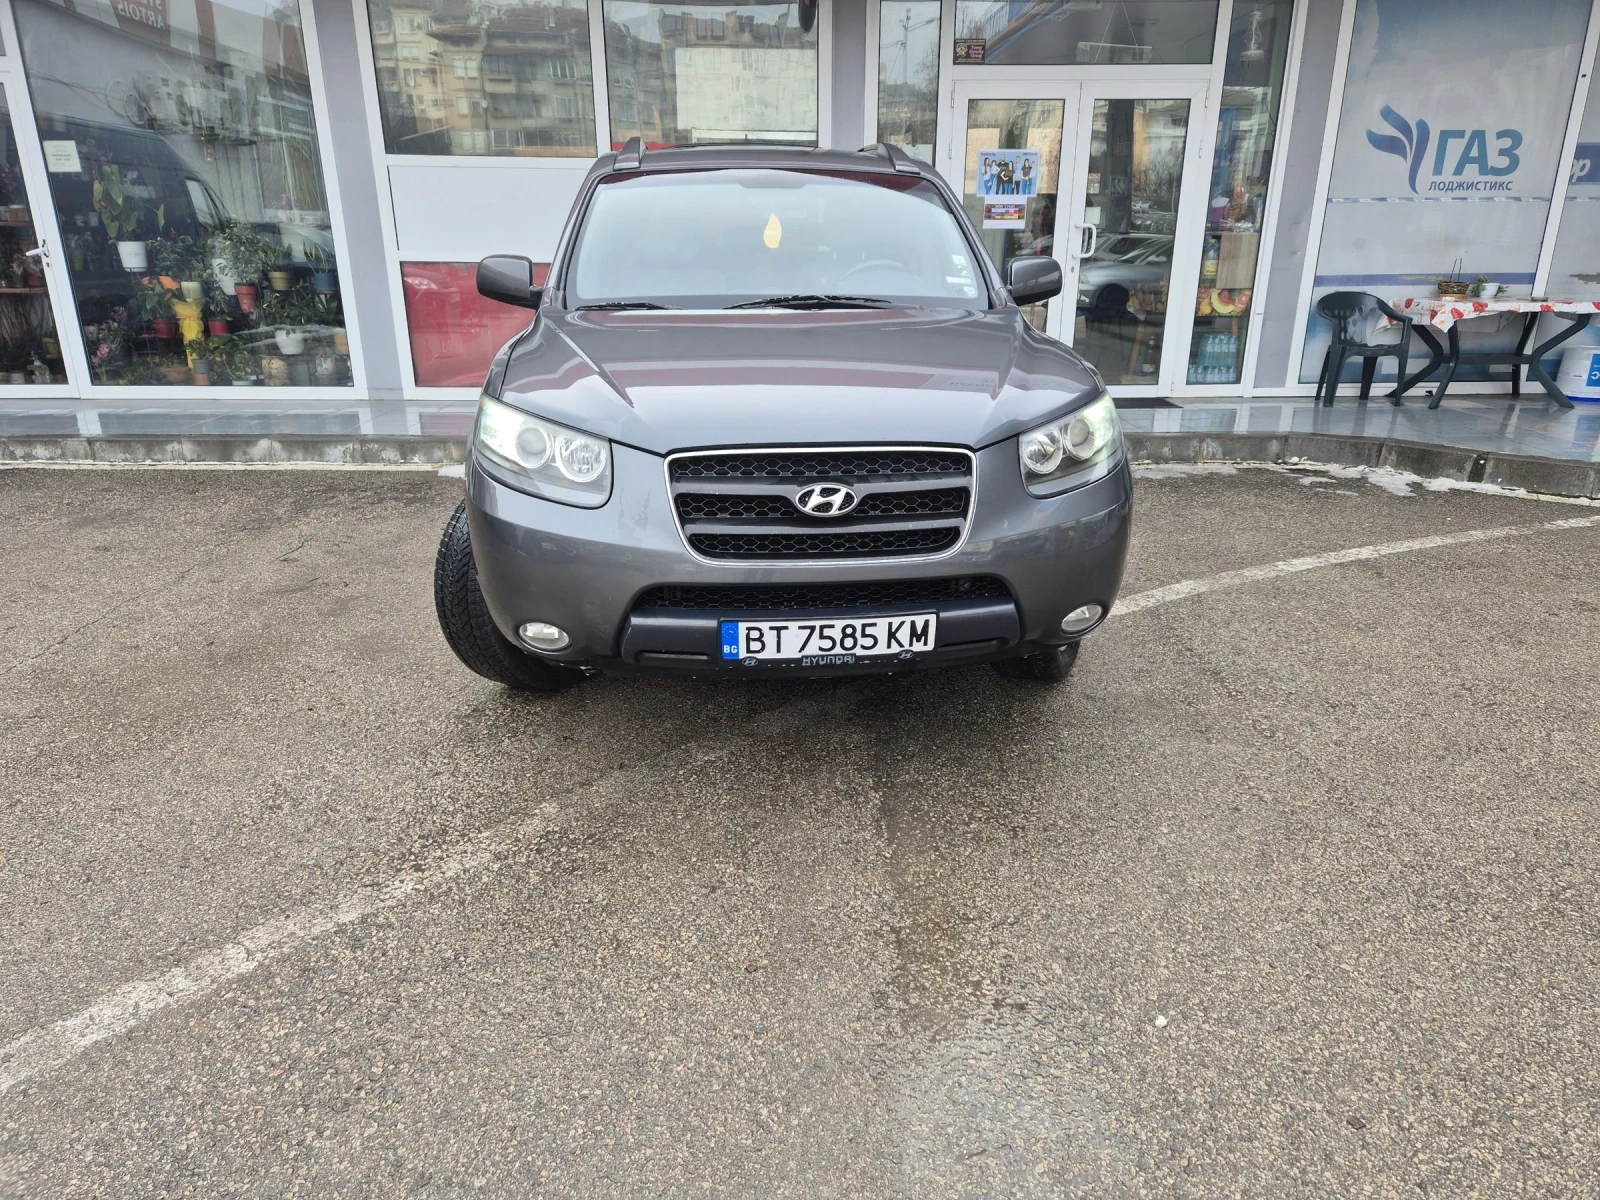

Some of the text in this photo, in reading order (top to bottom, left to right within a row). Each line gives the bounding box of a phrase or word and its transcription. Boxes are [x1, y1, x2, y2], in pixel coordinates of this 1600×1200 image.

[1432, 128, 1523, 177] ГАЗ
[1428, 181, 1513, 192] ЛОДЖИСТИКС
[745, 618, 930, 654] BT 7585 KM
[723, 645, 738, 653] BG
[802, 655, 855, 666] HYUNDAI
